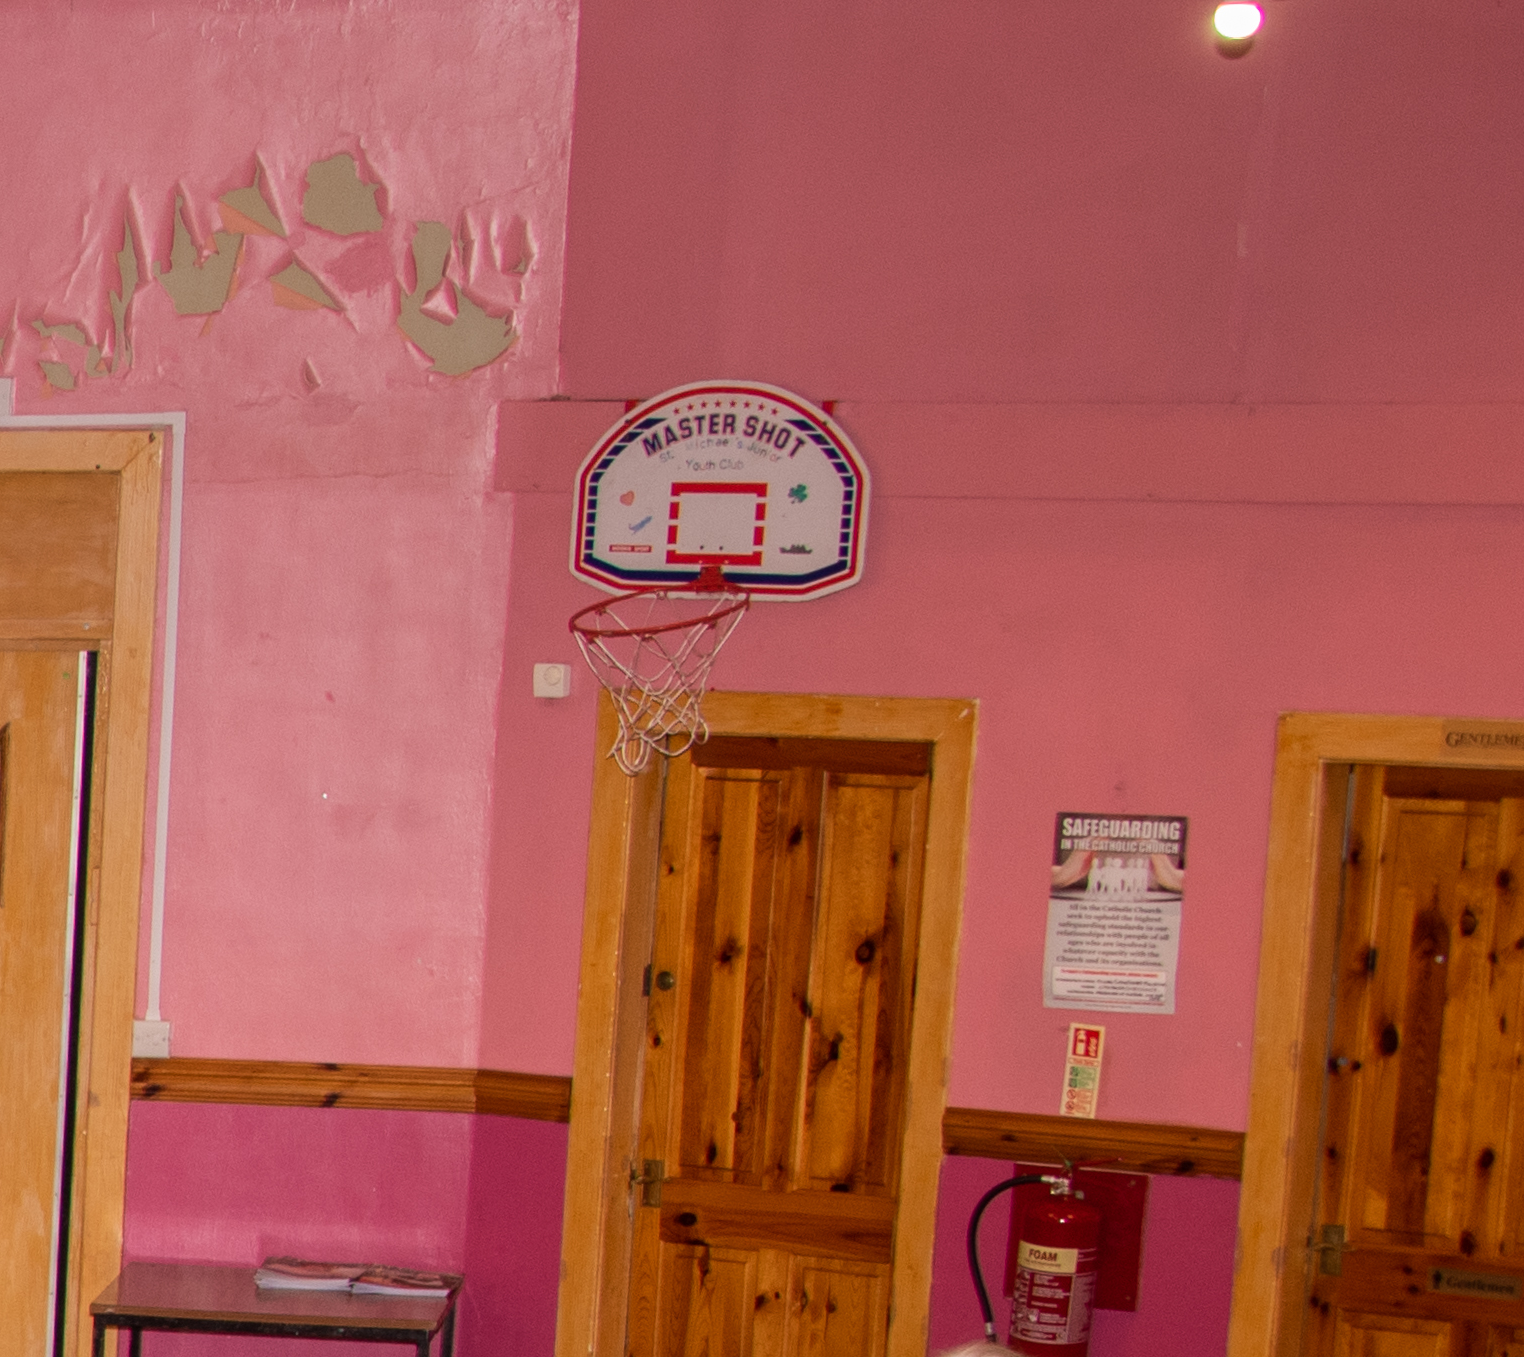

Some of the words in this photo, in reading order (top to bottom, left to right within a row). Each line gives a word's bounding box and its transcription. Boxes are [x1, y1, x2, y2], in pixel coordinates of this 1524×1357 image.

[641, 414, 736, 458] MASTER
[743, 415, 806, 459] SHOT
[1062, 818, 1180, 840] SAFEGUARDING
[1061, 839, 1072, 850] IN
[1073, 839, 1090, 851] THE
[1092, 839, 1137, 852] CATHOLIC
[1138, 841, 1179, 854] CHURCH
[1029, 1248, 1057, 1262] FOAM
